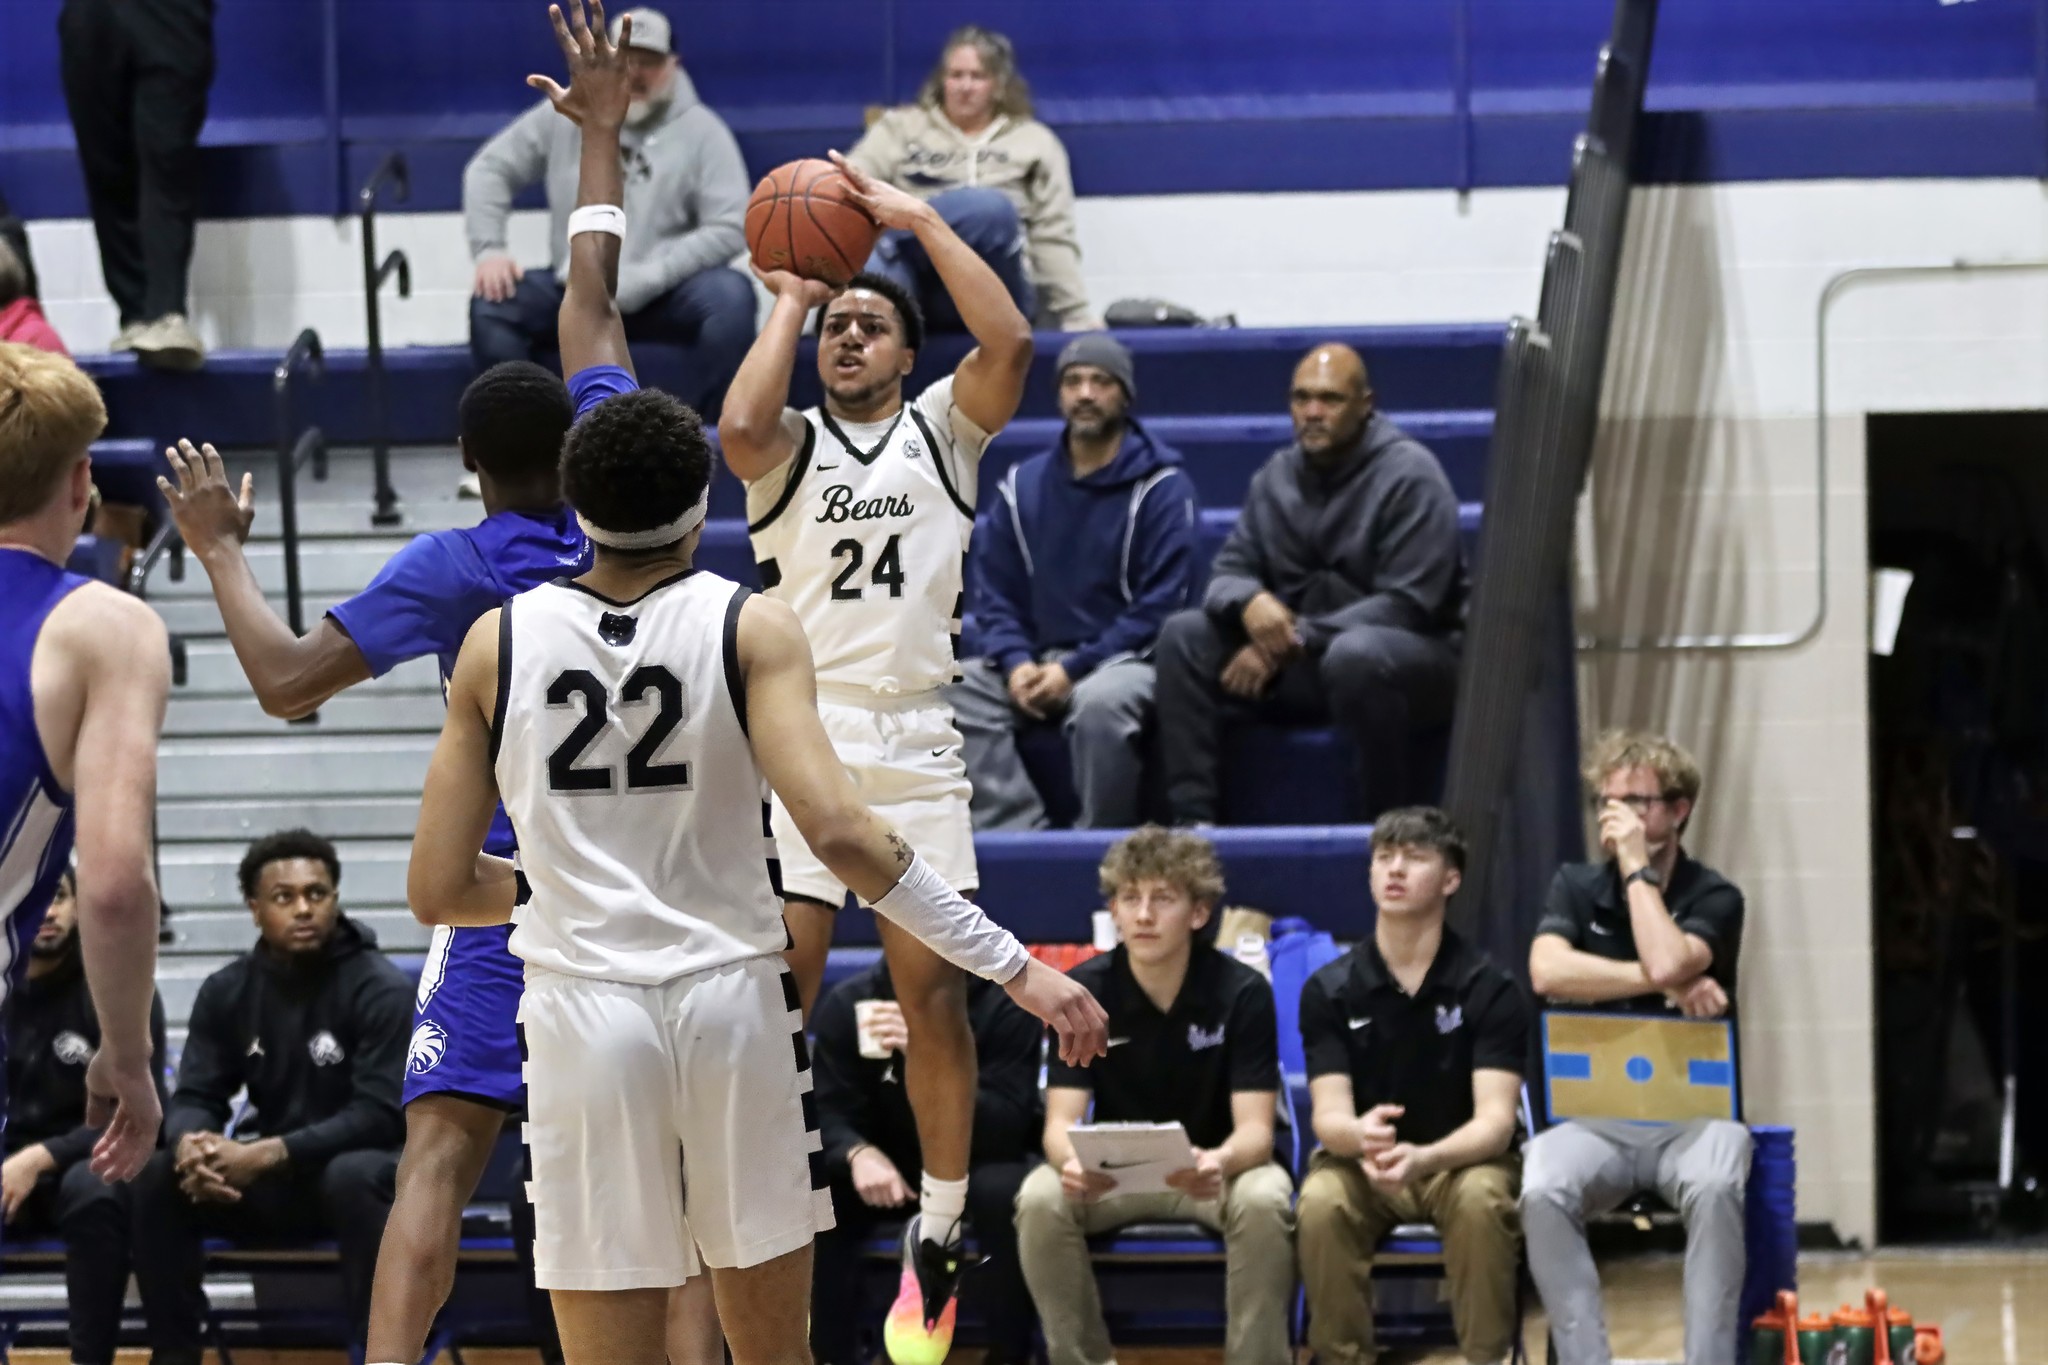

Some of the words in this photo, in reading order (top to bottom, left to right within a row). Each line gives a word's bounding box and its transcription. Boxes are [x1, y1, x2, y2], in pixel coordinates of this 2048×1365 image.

[815, 484, 915, 524] Bears
[831, 534, 906, 601] 24
[544, 664, 693, 796] 22
